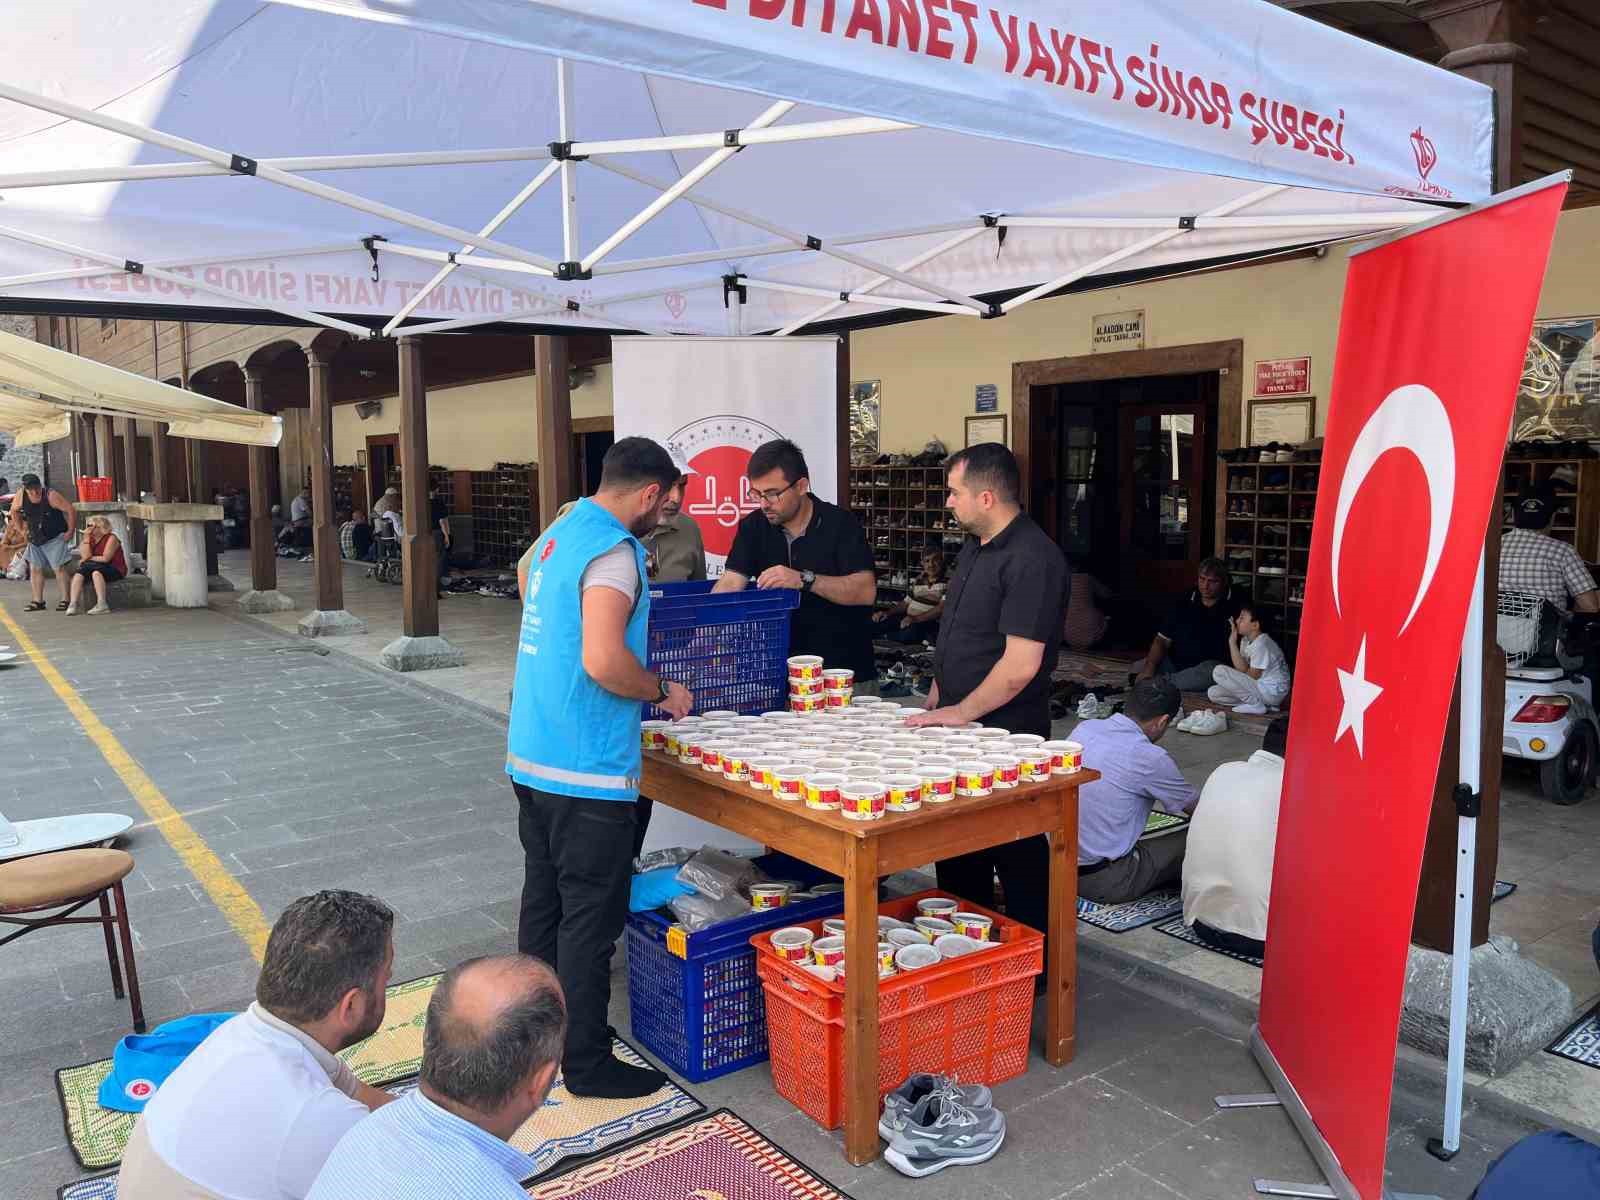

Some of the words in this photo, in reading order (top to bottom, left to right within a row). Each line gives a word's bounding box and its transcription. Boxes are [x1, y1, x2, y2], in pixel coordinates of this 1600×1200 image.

[989, 9, 1124, 100] VAKFI
[1126, 43, 1233, 129] SİNOP
[1239, 92, 1355, 165] ŞUBESİ
